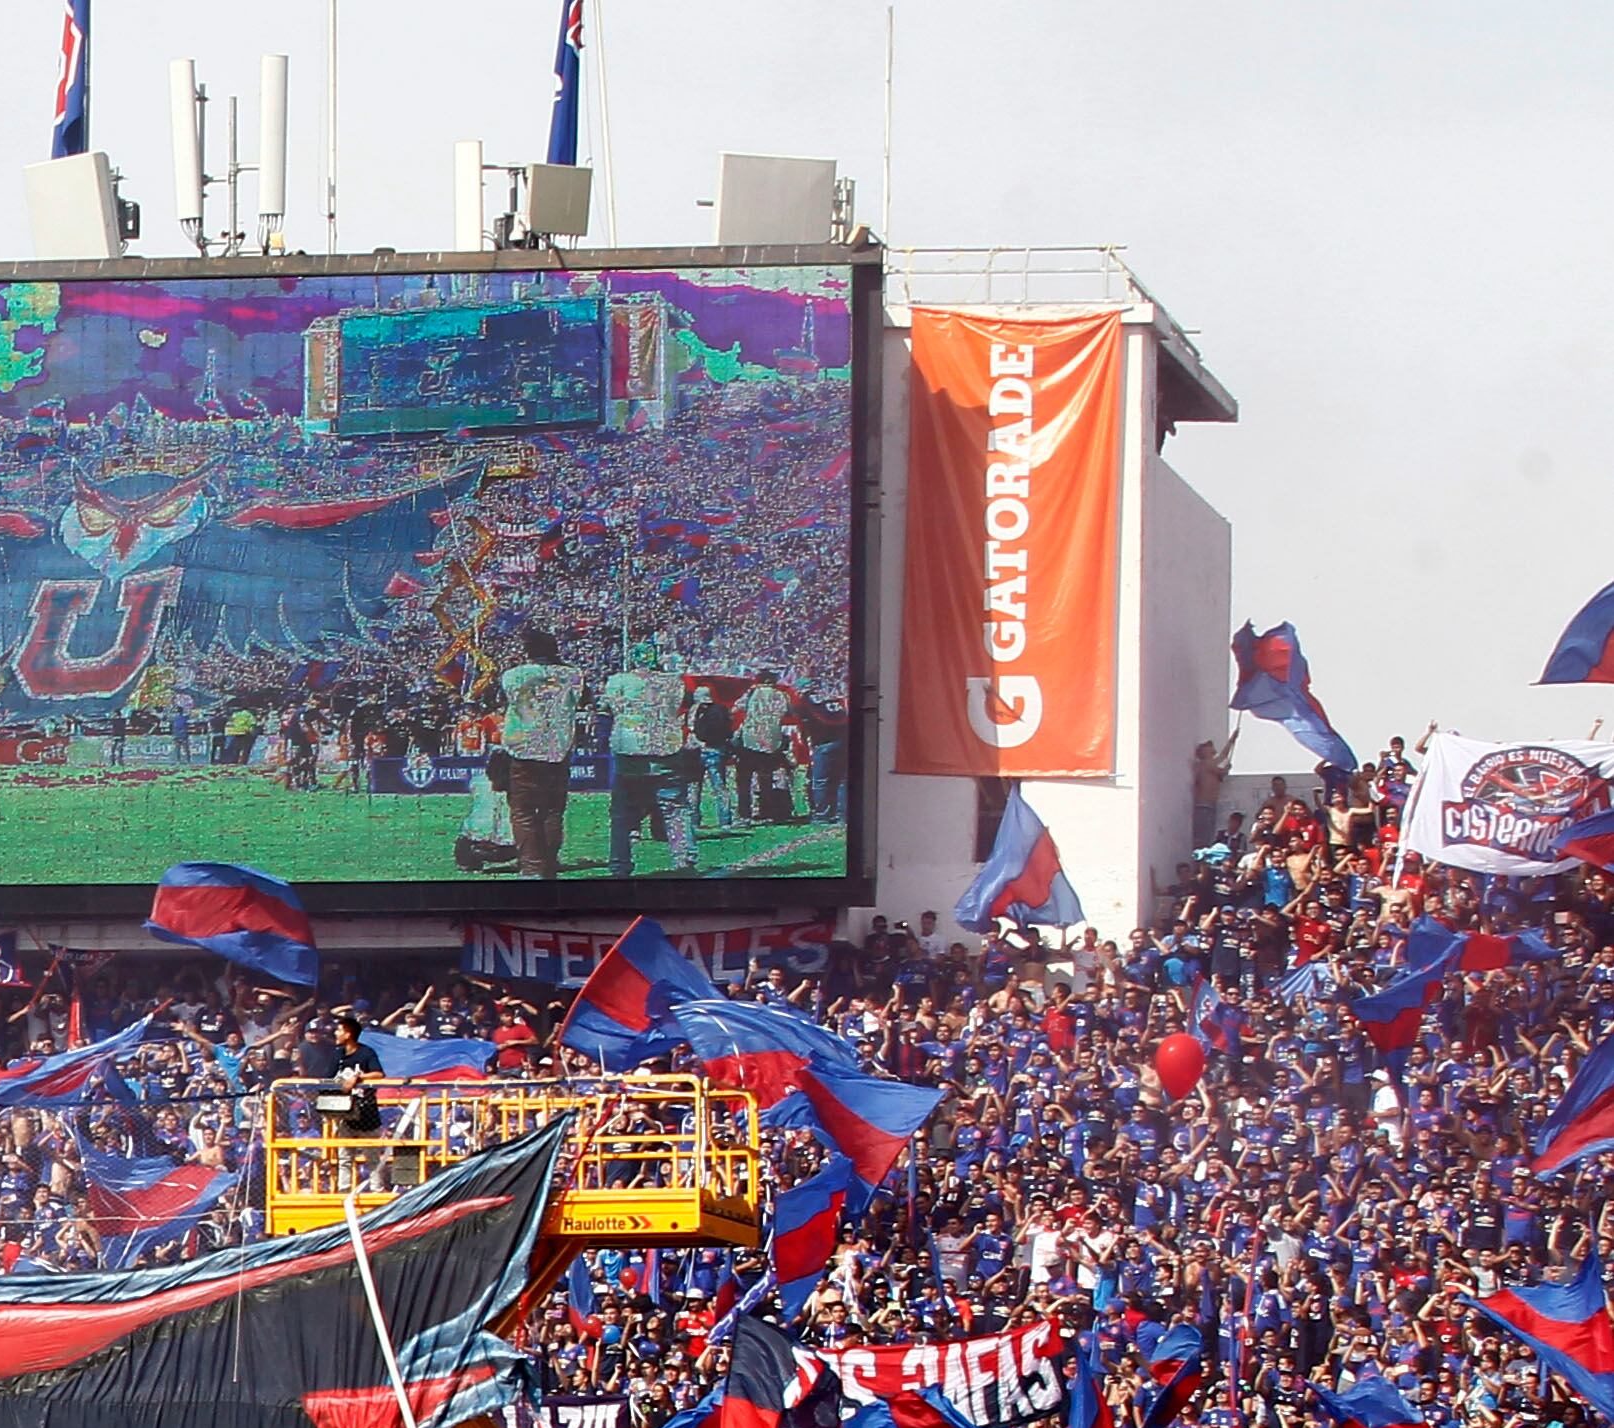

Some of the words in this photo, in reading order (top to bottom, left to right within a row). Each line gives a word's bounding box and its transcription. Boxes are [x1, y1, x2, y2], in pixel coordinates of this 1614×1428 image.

[981, 342, 1035, 661] GATORADE
[469, 922, 829, 983] INFEALES
[564, 1216, 626, 1232] Haulotte
